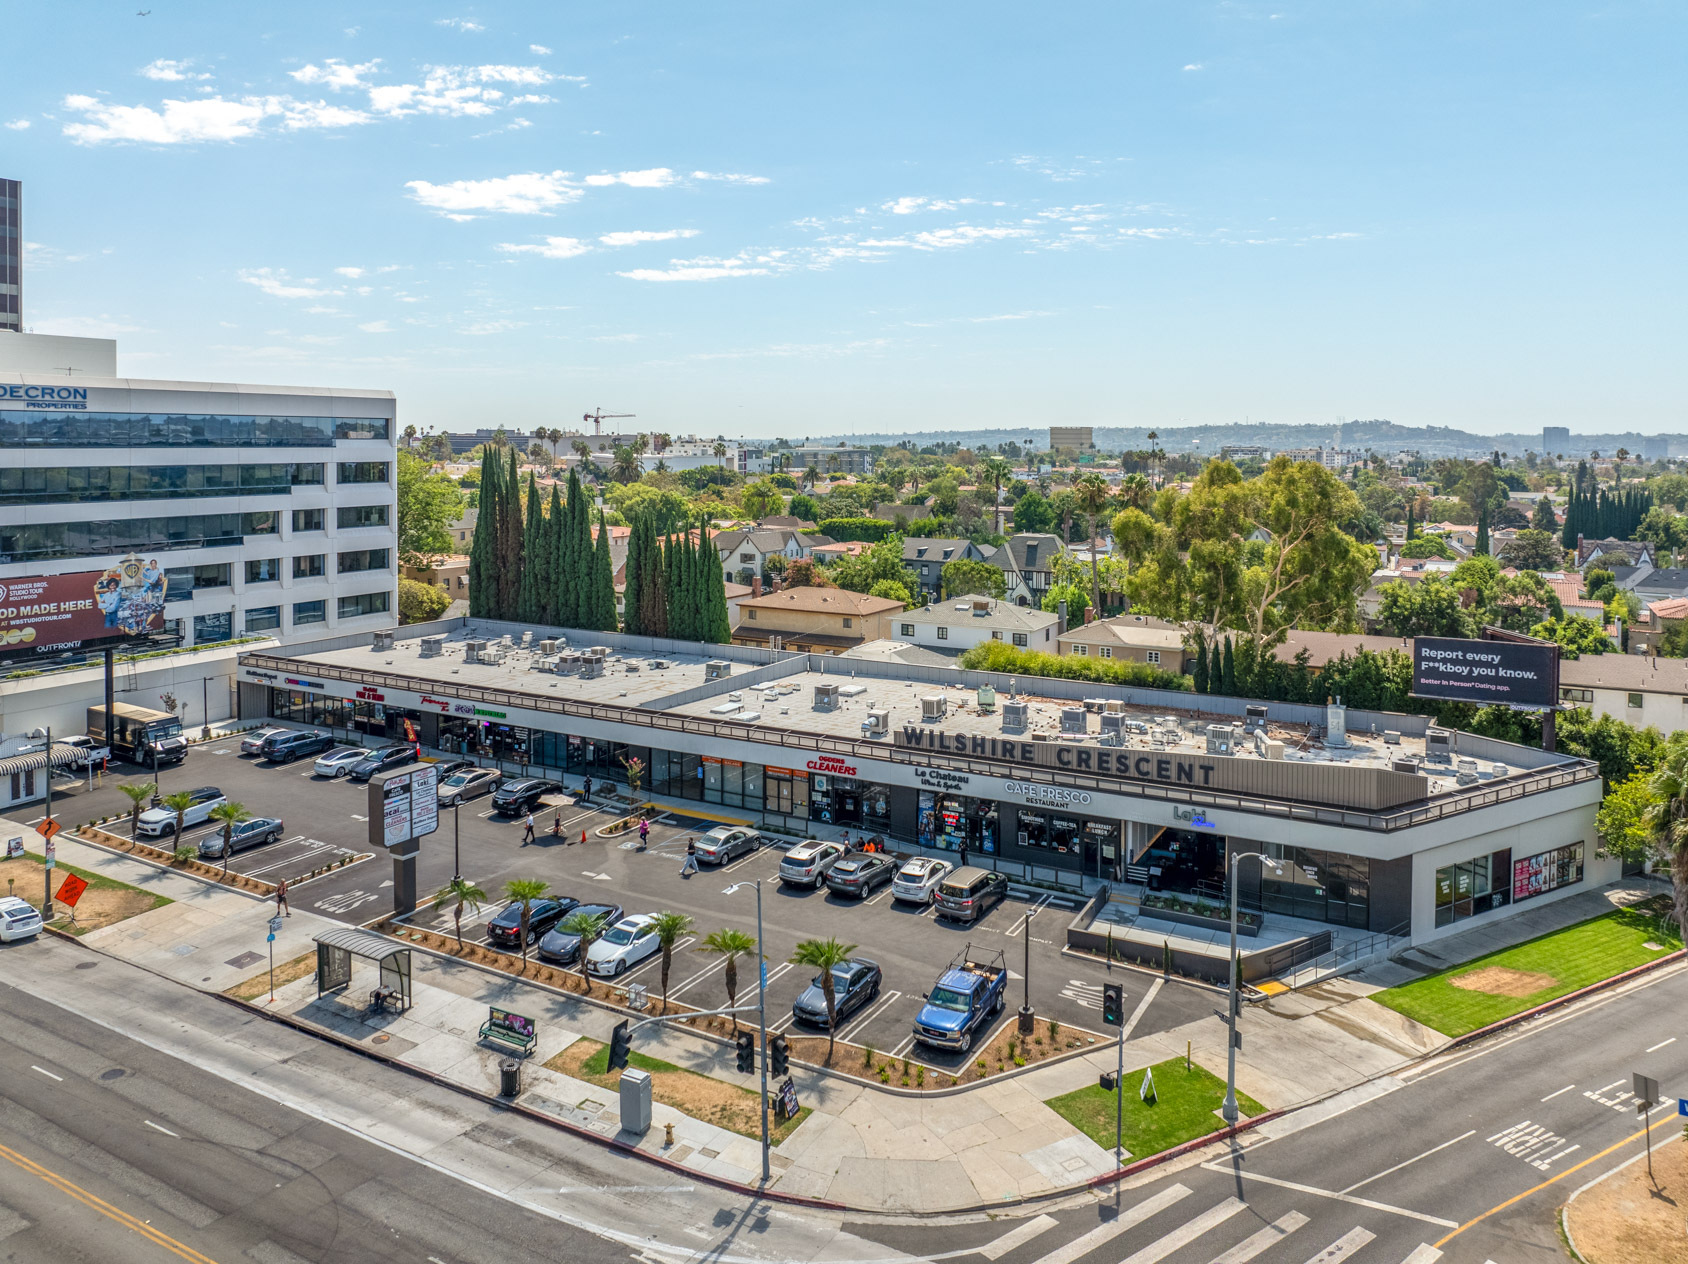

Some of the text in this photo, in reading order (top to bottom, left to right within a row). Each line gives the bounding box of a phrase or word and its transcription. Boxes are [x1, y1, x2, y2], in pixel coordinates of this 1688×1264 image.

[27, 402, 88, 410] PROPERTIES
[20, 603, 58, 616] MADE
[60, 600, 93, 612] HERE
[10, 614, 72, 625] WBSTUDIOTOUR.COM
[1421, 648, 1501, 664] Report every
[1472, 666, 1496, 677] you
[1499, 667, 1538, 679] know.
[1475, 682, 1496, 690] Dating
[902, 725, 1215, 786] WILSHIRE CRESCENT
[806, 760, 857, 776] CLEANERS
[915, 768, 969, 784] Le Chateau
[1005, 782, 1092, 804] CAFE FRESCO
[1025, 797, 1070, 809] RESTAURANT
[385, 816, 408, 827] CLEANERS
[1021, 815, 1044, 823] SMOOTHIES
[1087, 822, 1112, 830] BREAKFAST
[64, 879, 78, 887] ROAD
[64, 891, 80, 901] AHEAD
[65, 886, 78, 894] WORK
[314, 889, 378, 914] STOP
[1486, 1120, 1581, 1171] TURN
